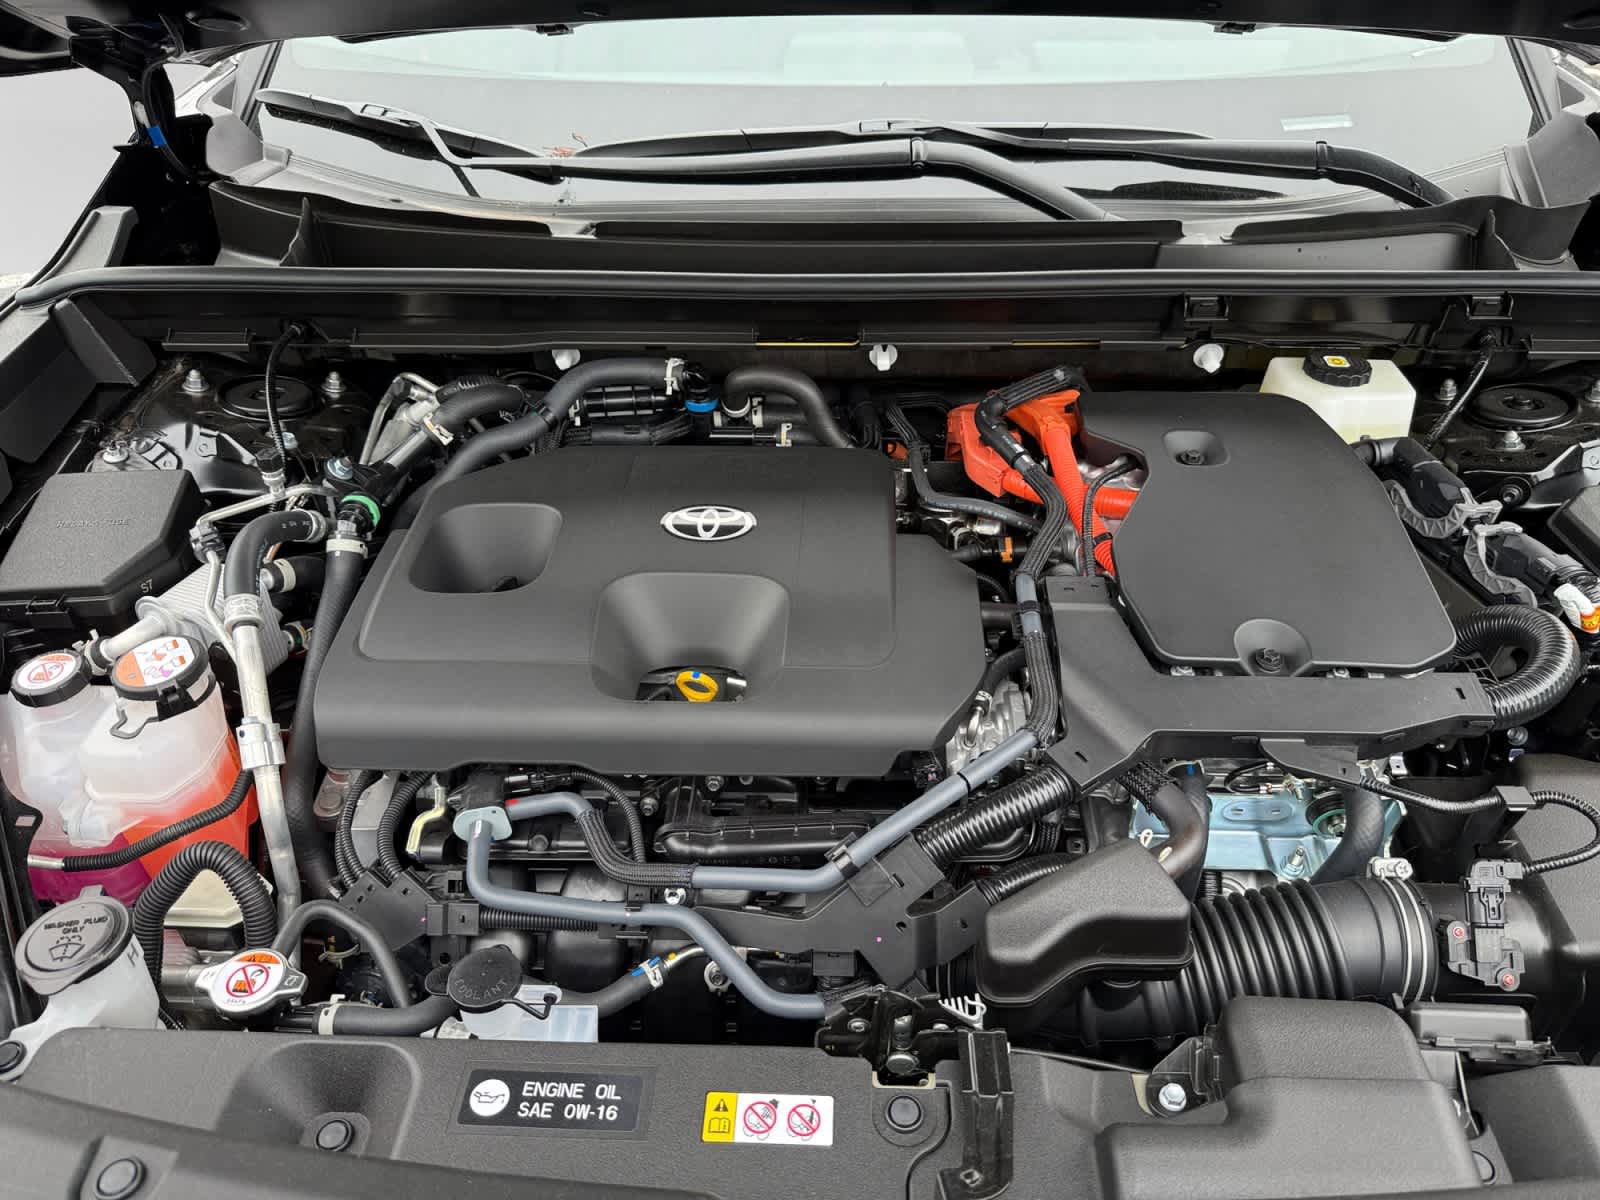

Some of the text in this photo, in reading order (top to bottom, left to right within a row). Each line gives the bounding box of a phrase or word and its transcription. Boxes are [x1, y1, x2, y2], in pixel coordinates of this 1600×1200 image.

[454, 978, 508, 1001] COOLANT
[522, 1081, 622, 1100] ENGINE OIL
[517, 1102, 618, 1121] SAE 0W-16
